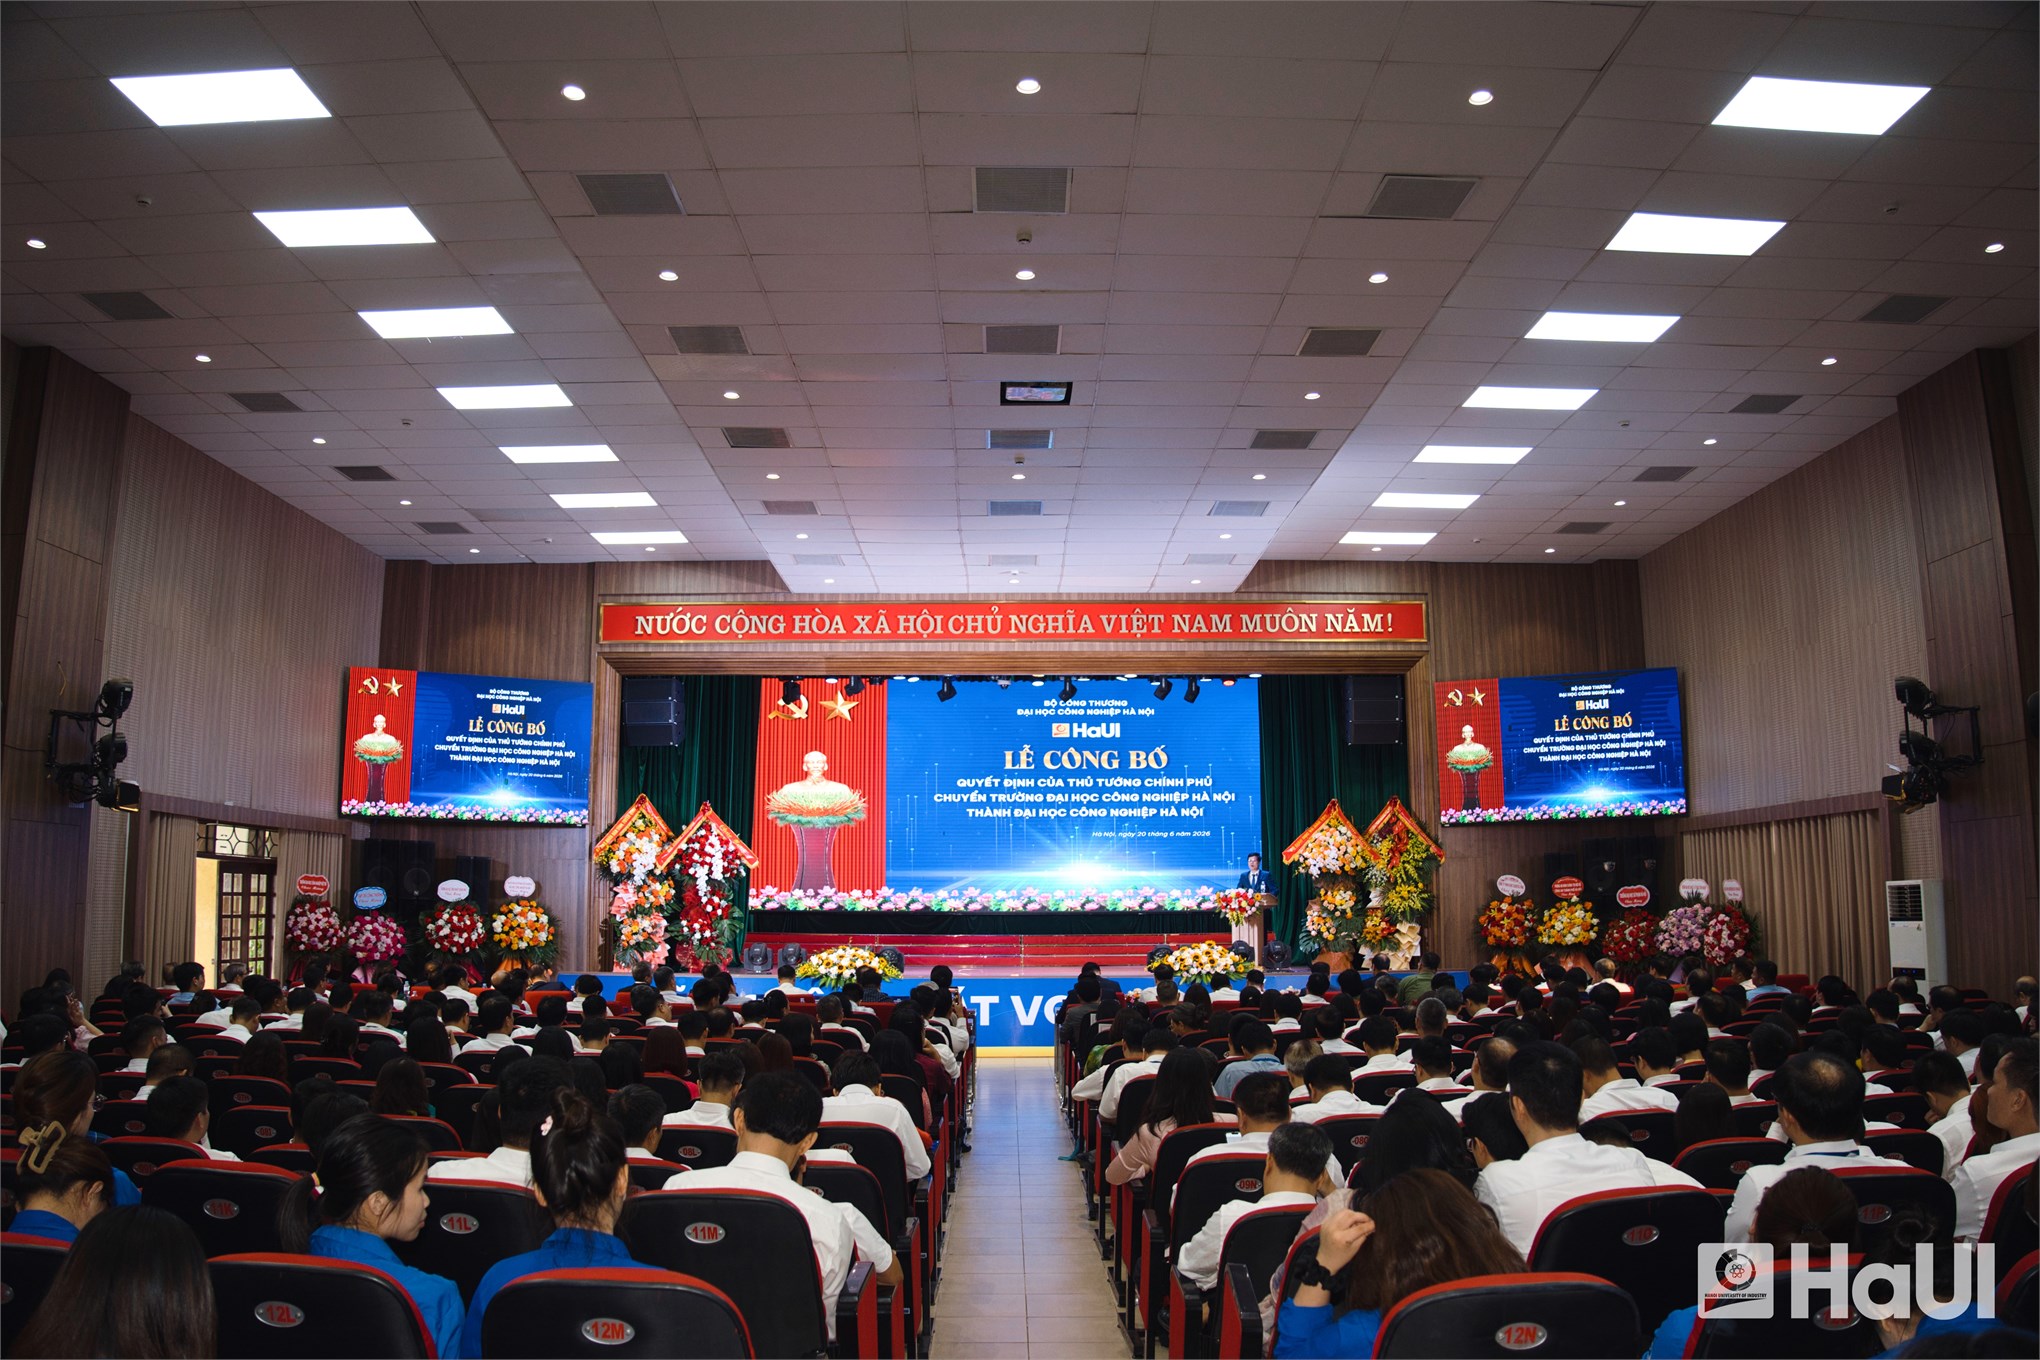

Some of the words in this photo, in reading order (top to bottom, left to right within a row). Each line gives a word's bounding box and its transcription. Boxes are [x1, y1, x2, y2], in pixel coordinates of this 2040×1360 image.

[635, 607, 706, 634] NƯỚC
[715, 609, 786, 638] CỘNG
[792, 608, 846, 634] HÒA
[853, 609, 891, 634] XÃ
[898, 609, 943, 638] HỘI
[948, 606, 1002, 634] CHỦ
[1009, 609, 1095, 634] NGHĨA
[1100, 608, 1164, 637] VIỆT
[1172, 613, 1232, 633] NAM
[1240, 608, 1316, 633] MUÔN
[1325, 608, 1393, 633] NĂM!
[502, 704, 525, 715] HaUI
[1044, 699, 1057, 708] BỘ
[1586, 699, 1609, 710] HaUI
[1017, 708, 1033, 717] ĐẠI
[1035, 708, 1056, 717] HỌC
[1058, 707, 1084, 715] CÔNG
[1087, 707, 1121, 717] NGHIỆP
[1123, 707, 1136, 715] HÀ
[1138, 707, 1154, 717] NỘI
[469, 716, 483, 732] LỄ
[487, 719, 523, 734] CÔNG
[527, 720, 546, 735] BỐ
[1554, 715, 1569, 731] LỄ
[1573, 716, 1609, 730] CÔNG
[1613, 712, 1632, 728] BỐ
[1073, 723, 1120, 738] HaUI
[1004, 744, 1035, 769] LỄ
[1043, 747, 1120, 769] CÔNG
[1129, 745, 1168, 769] BỐ
[957, 775, 1000, 787] QUYẾT
[1003, 779, 1035, 789] ĐỊNH
[1037, 776, 1064, 787] CỦA
[1067, 776, 1093, 787] THỦ
[1096, 776, 1141, 787] TƯỚNG
[1144, 776, 1184, 787] CHÍNH
[1187, 776, 1212, 787] PHỦ
[934, 790, 986, 802] CHUYỂN
[990, 792, 1044, 802] TRƯỜNG
[1046, 793, 1068, 804] ĐẠI
[1071, 793, 1099, 804] HỌC
[1102, 791, 1139, 802] CÔNG
[1142, 791, 1189, 804] NGHIỆP
[1192, 791, 1210, 801] HÀ
[1213, 791, 1235, 803] NỘI
[966, 806, 1011, 817] THÀNH
[1014, 809, 1036, 819] ĐẠI
[1039, 809, 1067, 819] HỌC
[1070, 806, 1107, 817] CÔNG
[1110, 806, 1157, 819] NGHIỆP
[1160, 806, 1178, 816] HÀ
[1181, 806, 1203, 818] NỘI
[1239, 1180, 1257, 1189] 09N
[448, 1216, 471, 1231] 11L
[692, 1226, 718, 1240] 11M
[265, 1304, 296, 1323] 12L
[591, 1321, 624, 1340] 12M
[1504, 1326, 1537, 1344] 12N
